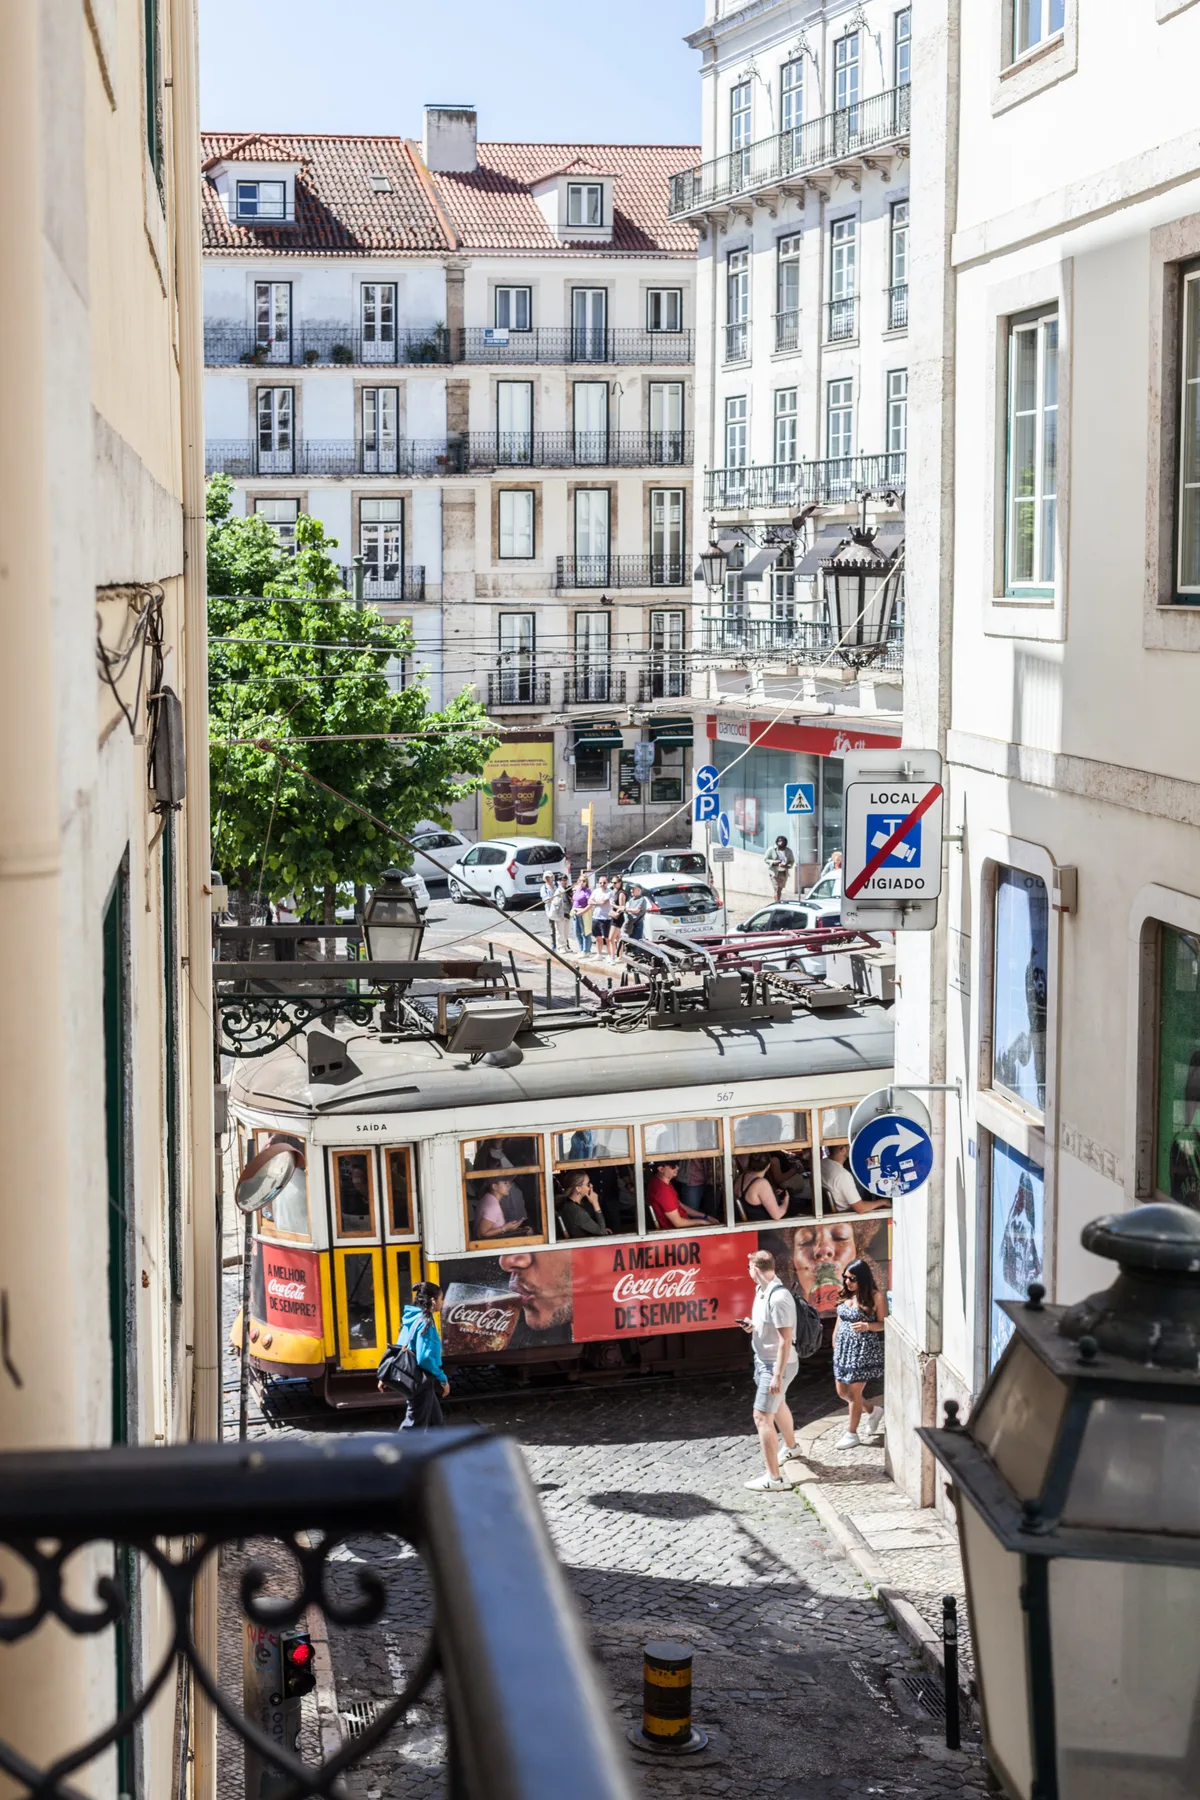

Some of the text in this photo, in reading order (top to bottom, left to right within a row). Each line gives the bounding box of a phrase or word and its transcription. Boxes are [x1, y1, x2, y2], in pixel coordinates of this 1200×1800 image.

[700, 796, 715, 820] P
[870, 792, 919, 805] LOCAL
[863, 878, 925, 890] VIGIADO
[717, 1091, 735, 1102] 567
[356, 1122, 387, 1132] SAÍDA
[613, 1242, 701, 1272] A MELHOR
[268, 1263, 307, 1283] A MELHOR
[613, 1268, 701, 1303] Coca-Cola
[270, 1296, 317, 1318] DE SEMPRE?
[615, 1298, 719, 1330] DE SEMPRE?
